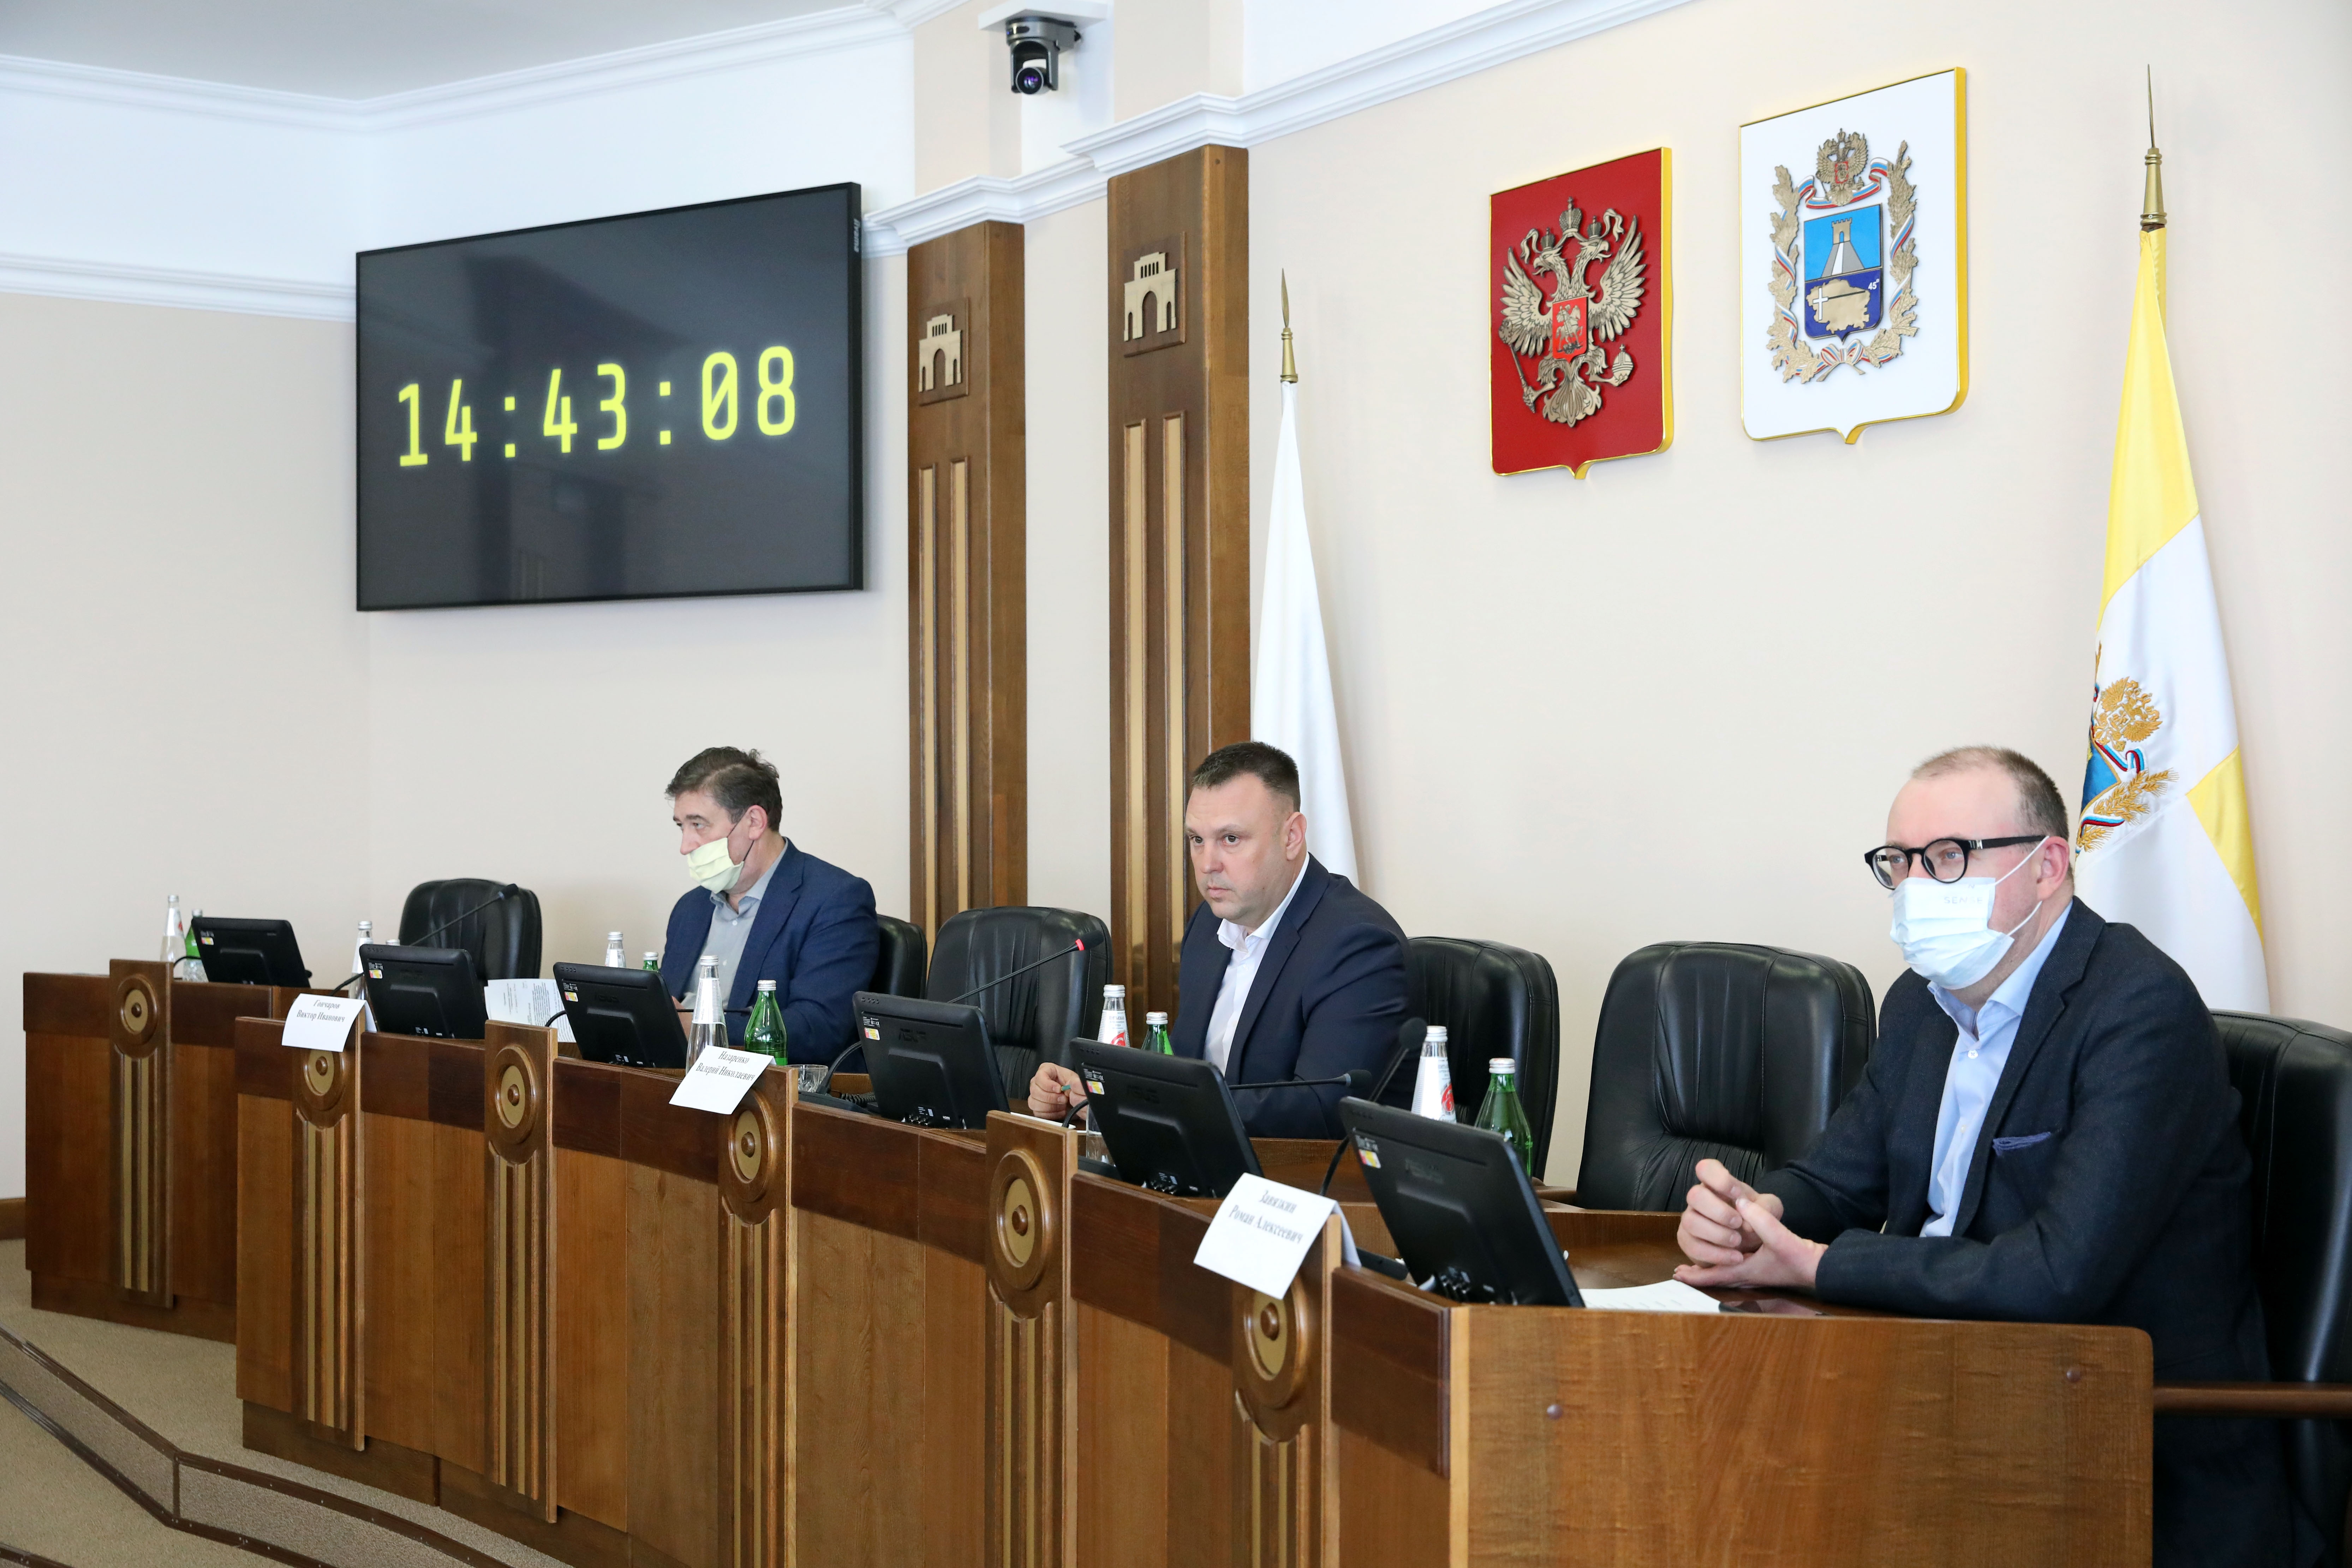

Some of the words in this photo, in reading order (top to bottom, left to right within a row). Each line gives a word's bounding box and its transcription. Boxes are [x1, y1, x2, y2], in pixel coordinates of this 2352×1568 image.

[398, 346, 795, 466] 14:43:08
[314, 1000, 341, 1010] Гончаров
[297, 1010, 317, 1021] Виктор
[317, 1012, 345, 1022] Иванович
[718, 1051, 750, 1064] Назаренко
[696, 1063, 720, 1075] Валерий
[719, 1067, 756, 1081] Николаевич
[1229, 1205, 1255, 1225] Роман
